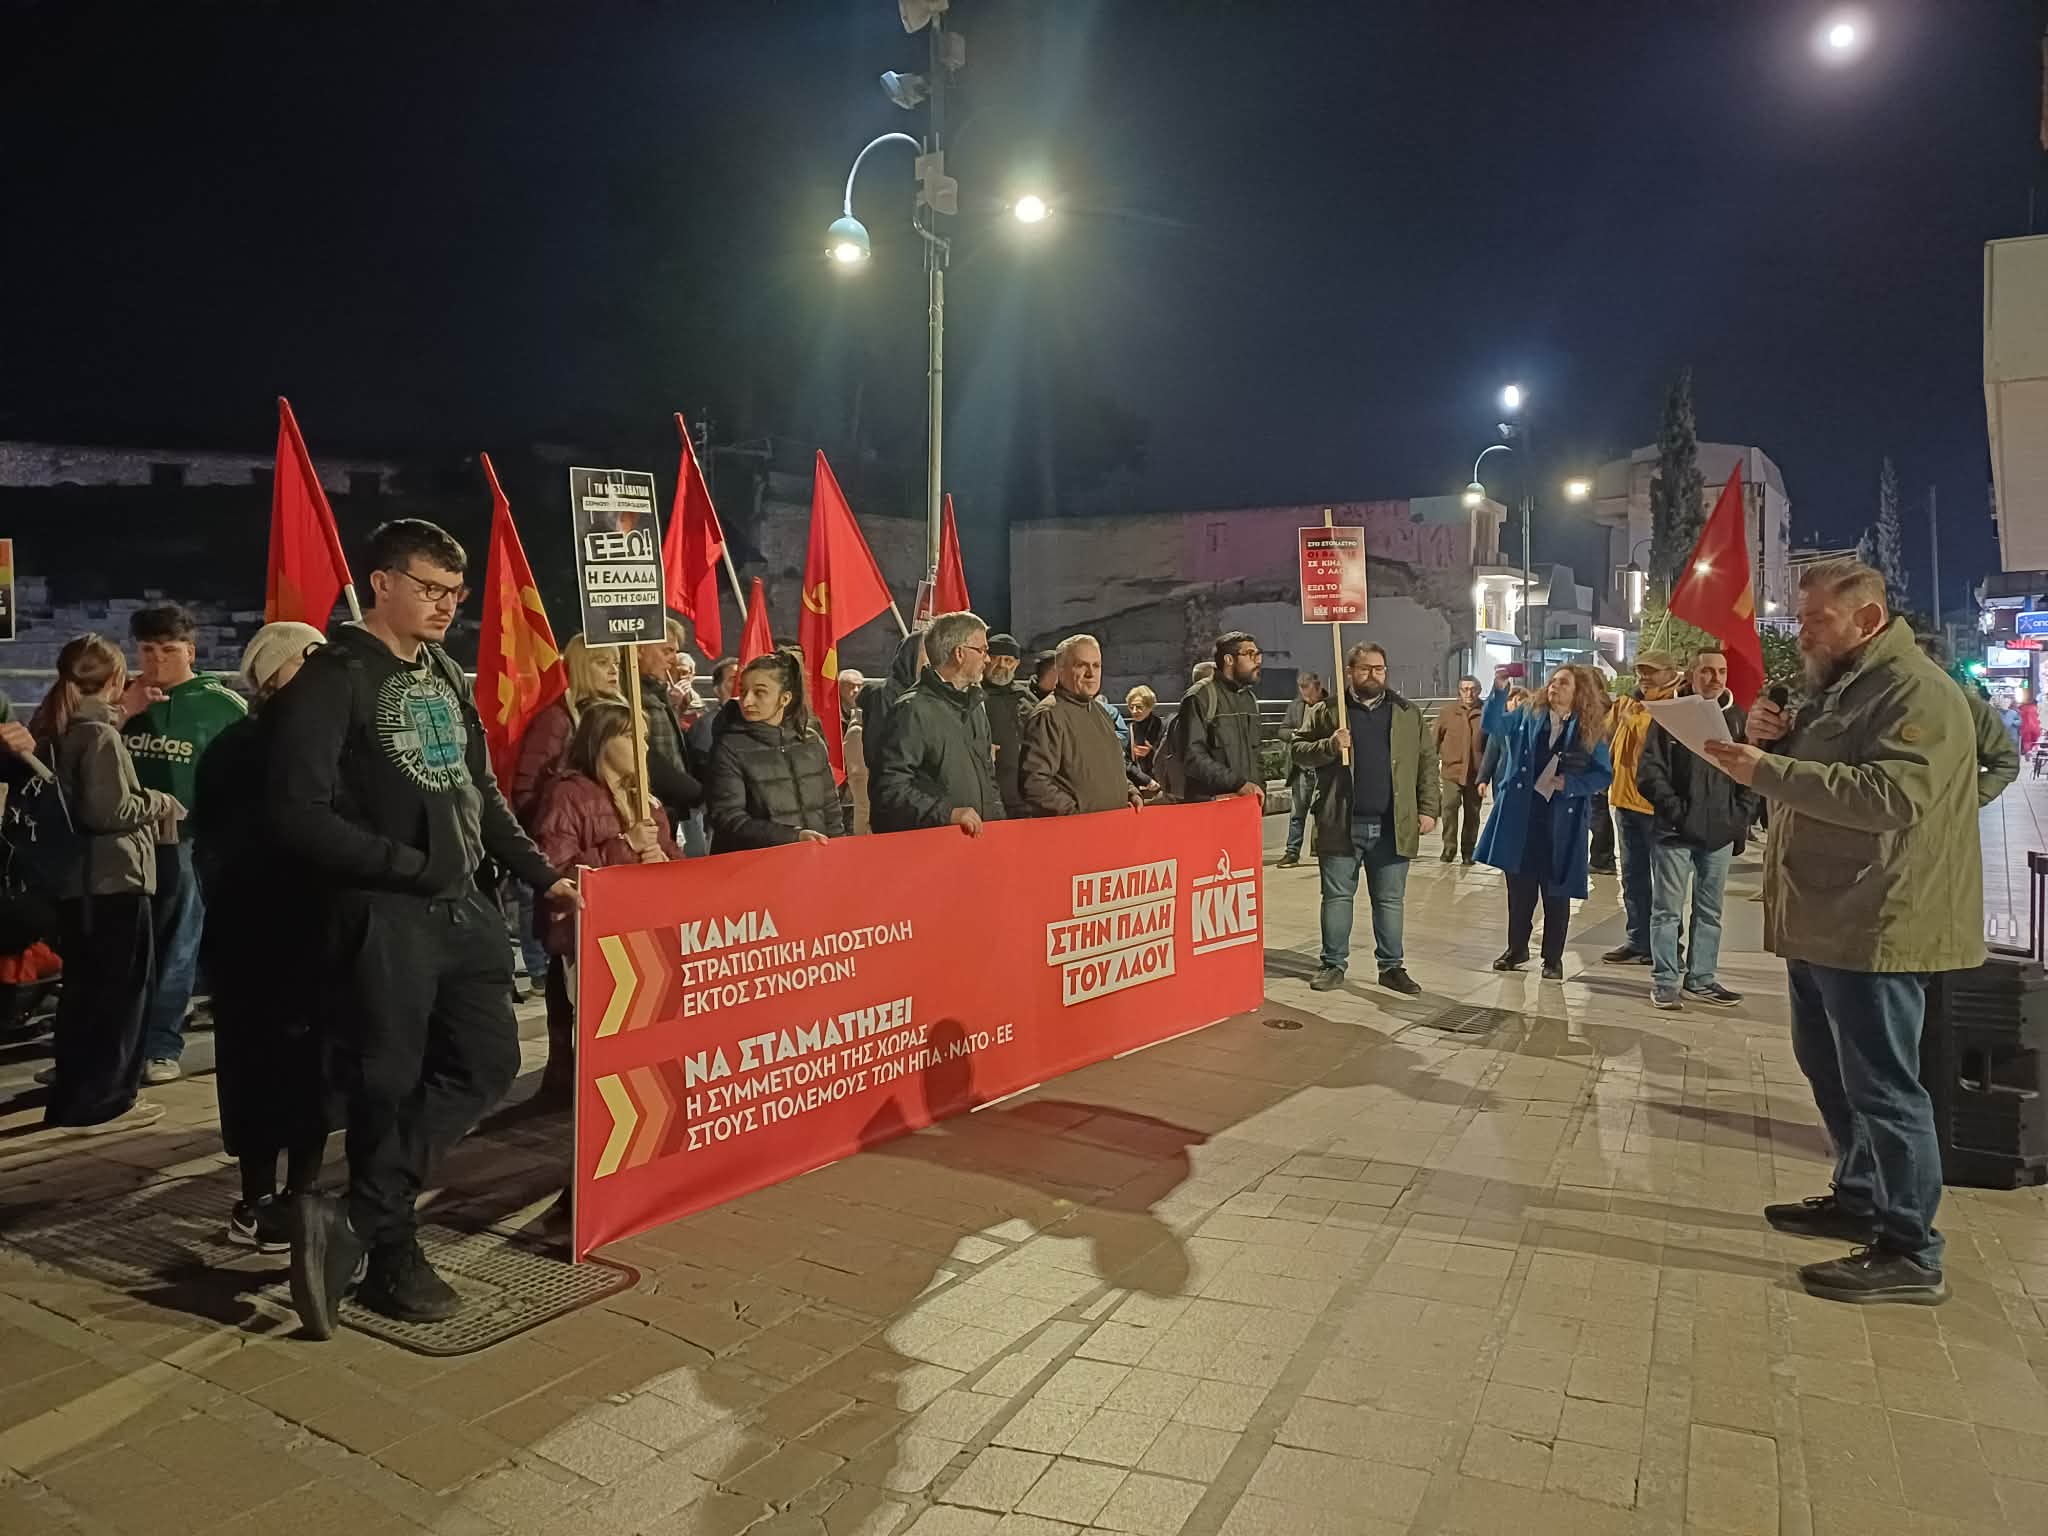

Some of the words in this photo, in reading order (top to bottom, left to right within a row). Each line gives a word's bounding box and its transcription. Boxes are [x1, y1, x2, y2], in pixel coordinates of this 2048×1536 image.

[590, 530, 652, 560] ΕΞΩ!
[588, 571, 598, 585] Η
[603, 570, 656, 584] ΕΛΛΑΔΑ
[591, 593, 612, 604] ΑΠΟ
[614, 593, 628, 603] ΤΗ
[630, 591, 656, 603] ΣΦΑΓΗ
[1326, 583, 1338, 591] ΤΟ
[609, 619, 638, 633] ΚΝΕ
[402, 749, 463, 784] JEANSW
[1077, 879, 1093, 908] Η
[1099, 865, 1173, 904] ΕΛΠΙΔΑ
[1192, 880, 1257, 943] ΚΚΕ
[679, 908, 779, 956] ΚΑΜΙΑ
[681, 939, 806, 987] ΣΤΡΑΤΙΩΤΙΚΗ
[811, 919, 913, 959] ΑΠΟΣΤΟΛΗ
[1051, 917, 1113, 957] ΣΤΗΝ
[1117, 904, 1171, 941] ΠΑΛΗ
[683, 980, 751, 1018] ΕΚΤΟΣ
[754, 956, 857, 1001] ΣΥΝΟΡΩΝ!
[1067, 959, 1113, 996] ΤΟΥ
[1115, 943, 1170, 982] ΛΑΟΥ
[684, 1046, 732, 1089] ΝΑ
[738, 996, 913, 1073] ΣΤΑΜΑΤΗΣΕΙ
[686, 1094, 702, 1120] Η
[707, 1054, 837, 1114] ΣΥΜΜΕΤΟΧΗ
[840, 1043, 874, 1071] ΤΗΣ
[876, 1024, 928, 1060] ΧΩΡΑΣ
[687, 1106, 758, 1152] ΣΤΟΥΣ
[761, 1070, 868, 1126] ΠΟΛΕΜΟΥΣ
[871, 1057, 904, 1086] ΤΩΝ
